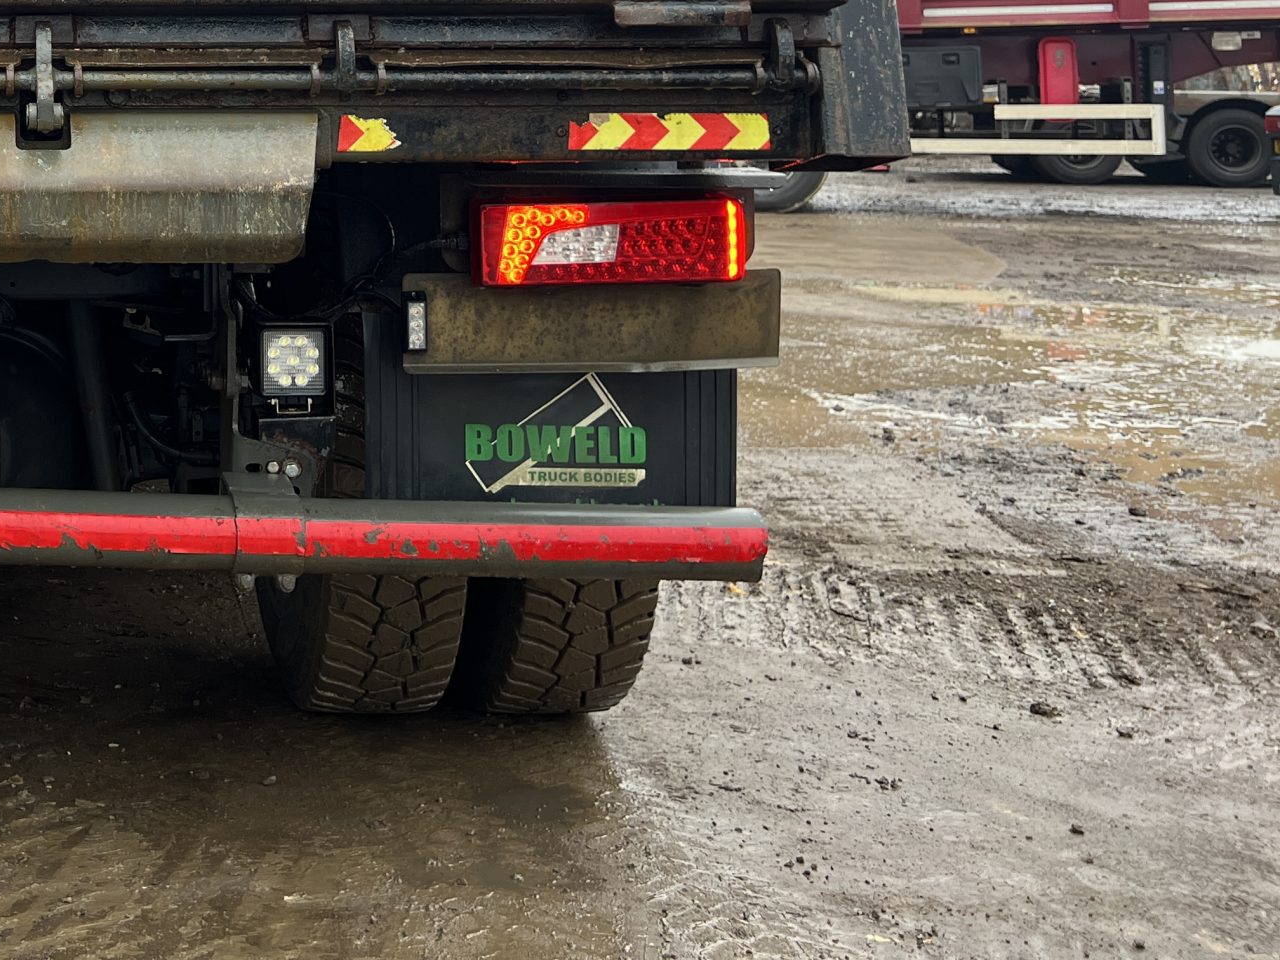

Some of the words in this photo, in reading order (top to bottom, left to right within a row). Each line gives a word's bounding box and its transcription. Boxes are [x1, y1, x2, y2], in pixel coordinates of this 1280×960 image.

[464, 423, 647, 464] BOWELD
[528, 471, 579, 482] TRUCK
[583, 472, 636, 483] BODIES
